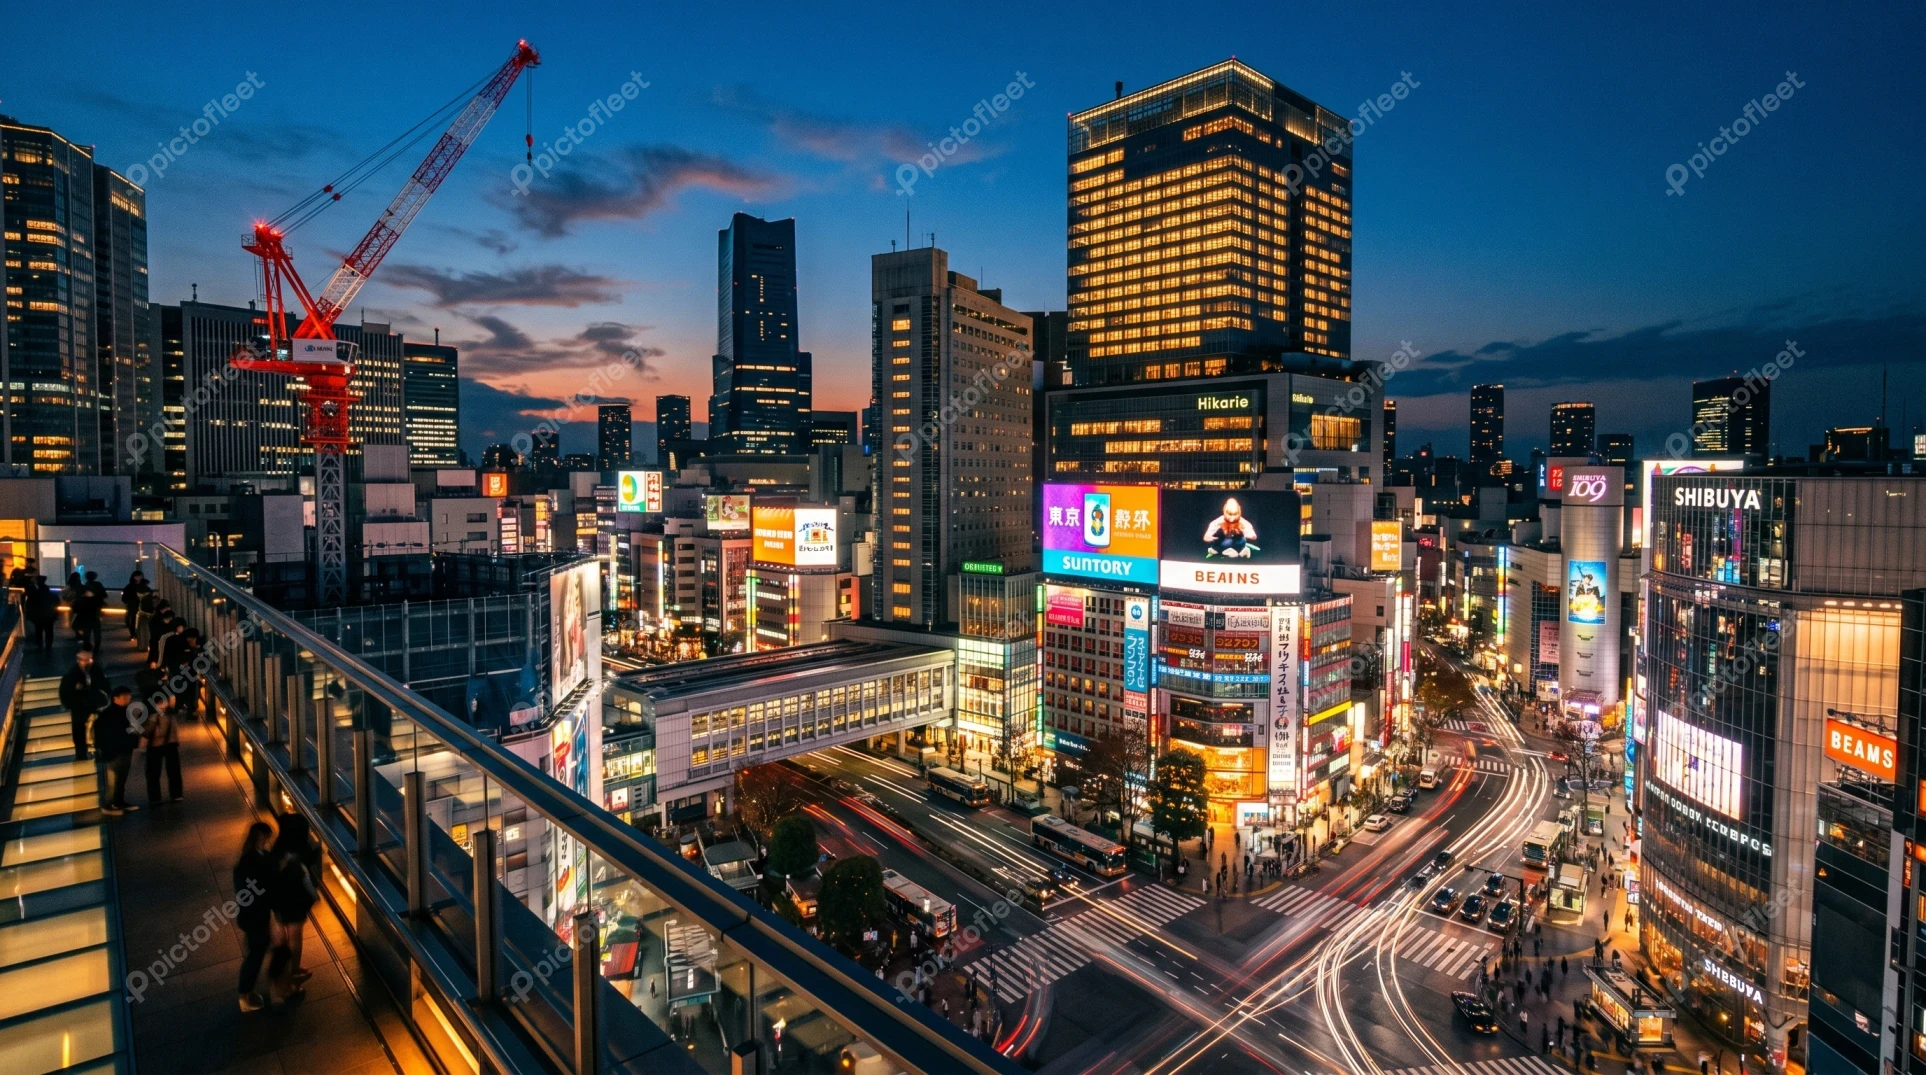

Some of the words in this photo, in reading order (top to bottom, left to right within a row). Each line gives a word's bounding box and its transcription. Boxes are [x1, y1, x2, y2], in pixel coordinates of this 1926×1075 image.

[1198, 396, 1248, 410] Hikarie
[1568, 481, 1606, 502] 109
[1675, 487, 1760, 510] SHIBUYA
[1049, 506, 1080, 527] 東京
[1063, 556, 1132, 576] SUNTORY
[1831, 730, 1893, 769] BEAMS
